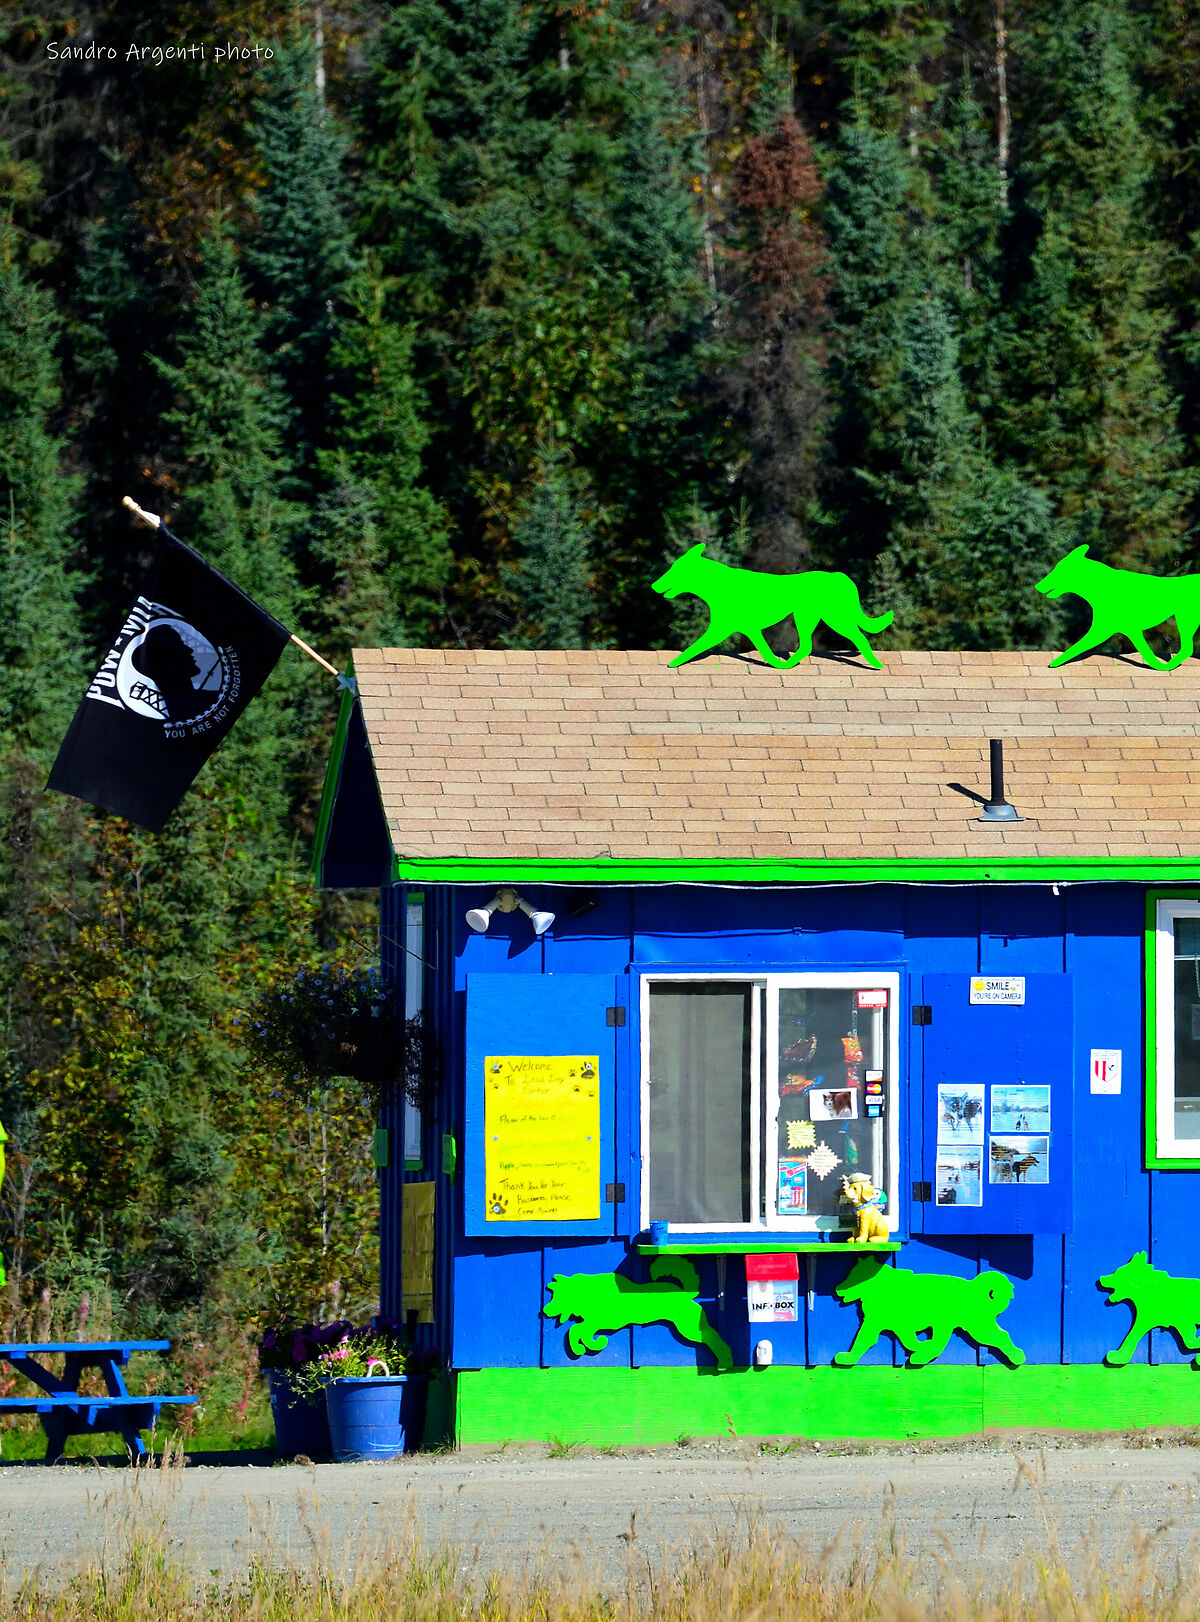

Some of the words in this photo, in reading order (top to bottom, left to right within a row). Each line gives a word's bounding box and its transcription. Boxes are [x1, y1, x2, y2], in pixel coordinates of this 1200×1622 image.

[165, 729, 186, 738] YOU
[192, 721, 213, 735] ARE
[213, 705, 230, 723] NOT
[224, 645, 241, 703] FORGOTTEN
[986, 982, 1009, 990] SMILE
[508, 1060, 552, 1072] Welcome
